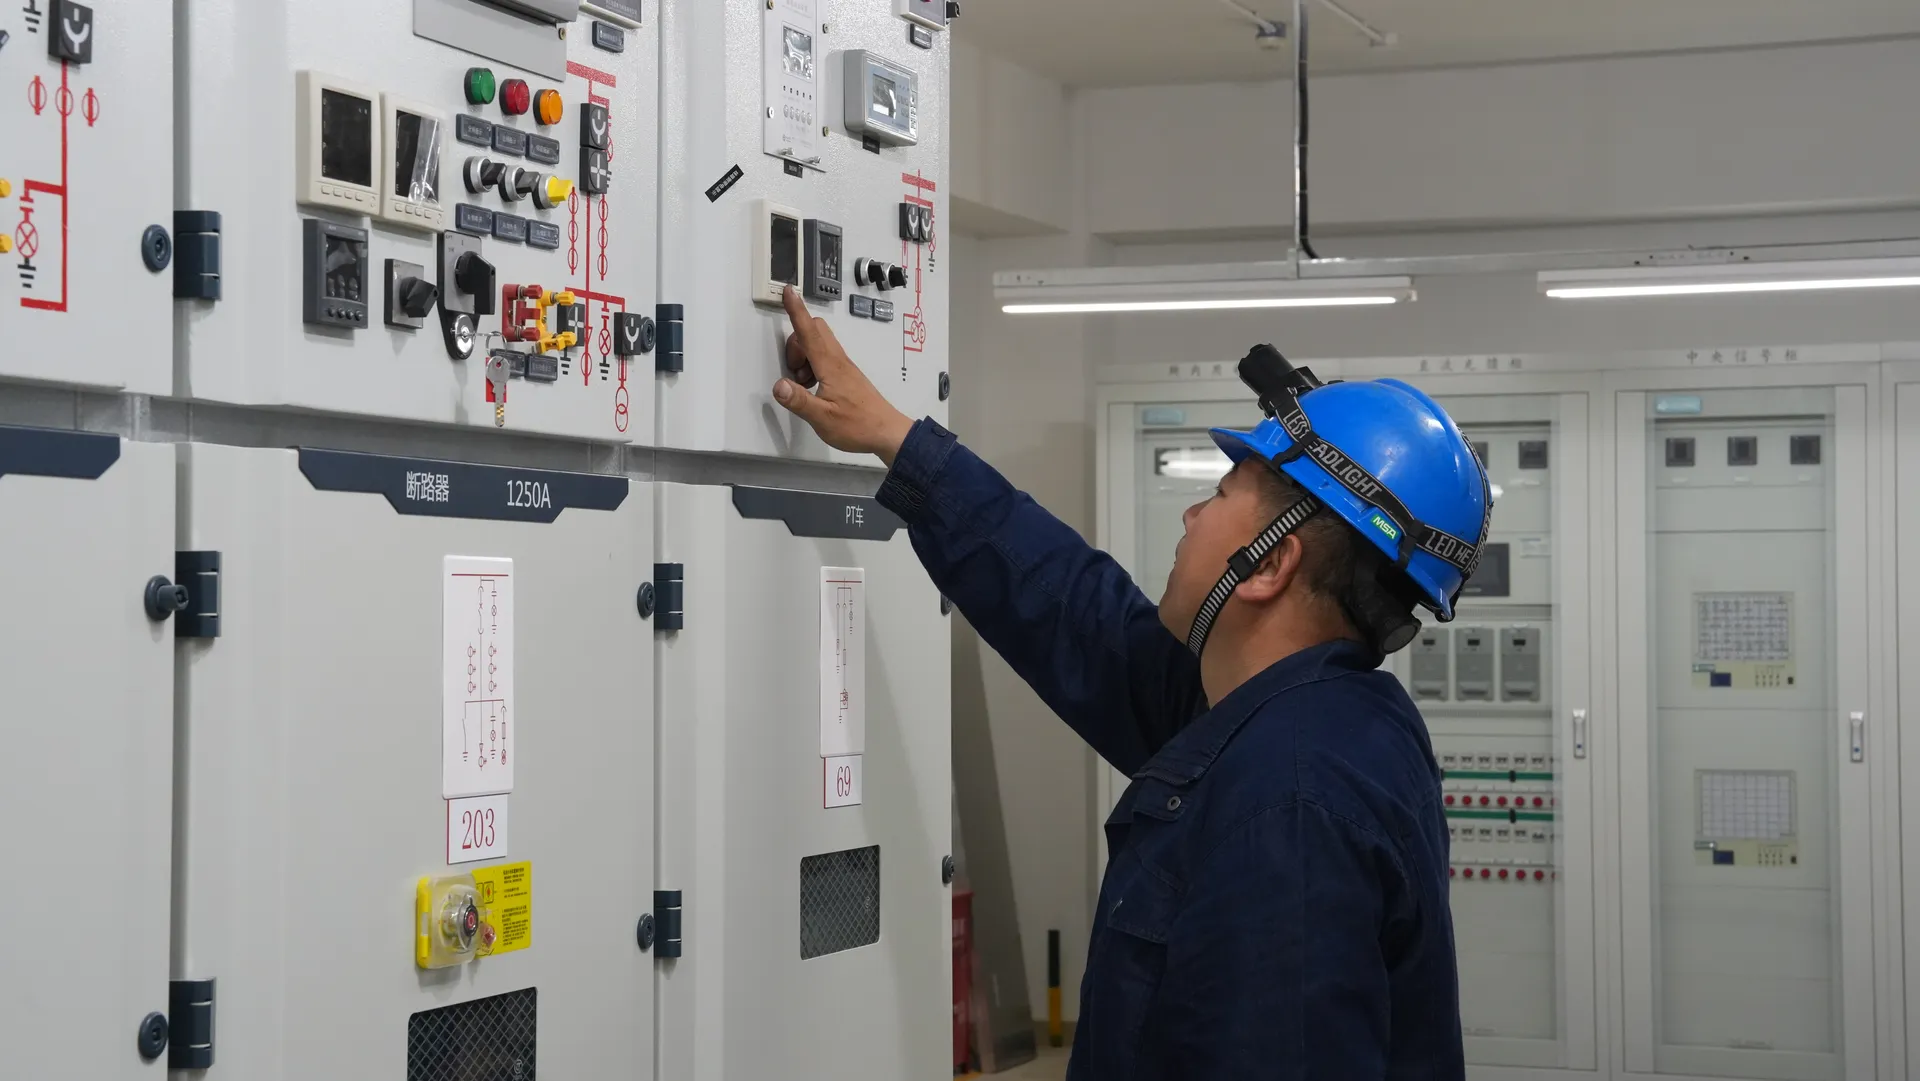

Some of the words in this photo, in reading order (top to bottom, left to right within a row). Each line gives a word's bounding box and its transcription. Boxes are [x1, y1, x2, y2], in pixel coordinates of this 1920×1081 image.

[406, 471, 449, 502] 断路器
[506, 480, 551, 508] 1250A
[845, 504, 864, 528] PT车
[1373, 516, 1397, 539] MSA
[1425, 531, 1456, 558] LED
[837, 765, 851, 797] 69
[462, 808, 495, 850] 203
